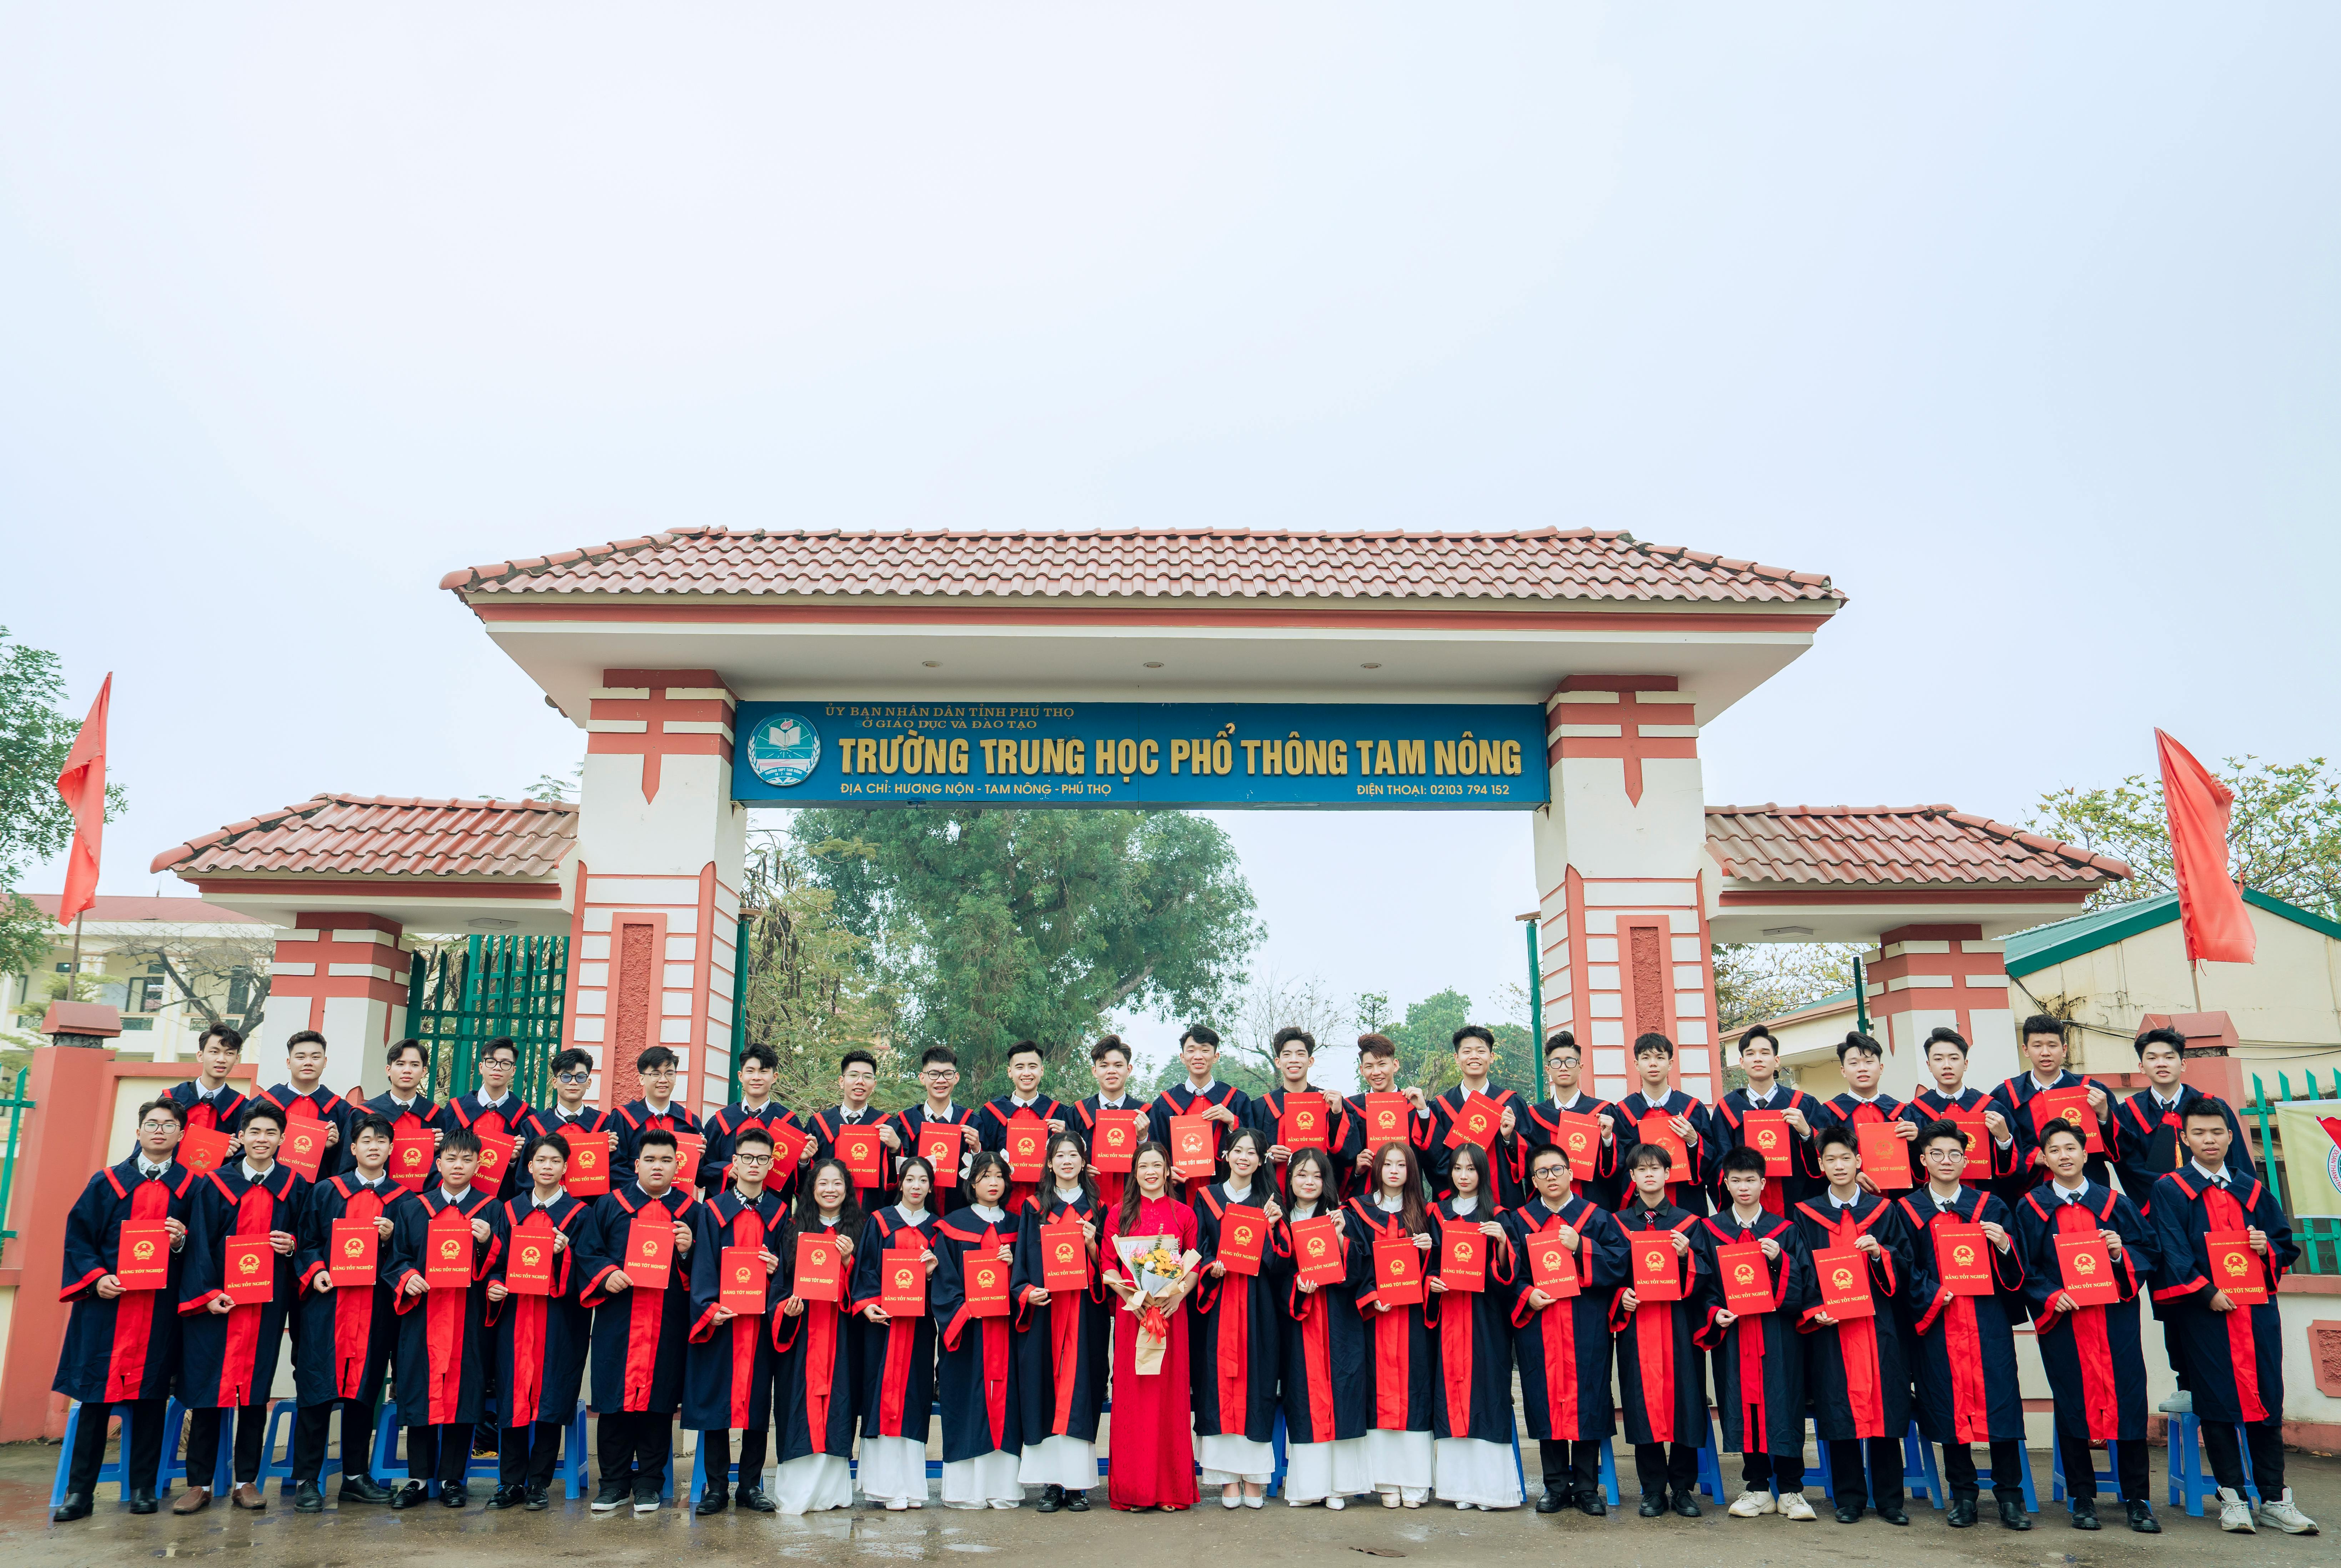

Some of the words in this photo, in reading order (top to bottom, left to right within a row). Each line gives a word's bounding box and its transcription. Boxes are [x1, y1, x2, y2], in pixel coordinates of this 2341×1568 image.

[825, 703, 845, 715] ỦY
[850, 707, 881, 716] BAN
[885, 705, 930, 716] NHÂN
[933, 705, 965, 716] DÂN
[969, 703, 1006, 717] TỈNH
[1009, 705, 1040, 717] PHÚ
[1043, 708, 1074, 719] THỌ
[876, 717, 914, 728] GIÁO
[918, 720, 946, 730] DỤC
[950, 718, 968, 728] VÀ
[971, 718, 1004, 728] ĐÀO
[1007, 720, 1037, 730] TẠO
[838, 729, 969, 775] TRƯỜNG
[980, 738, 1085, 775] TRUNG
[1096, 738, 1159, 783] HỌC
[1171, 723, 1236, 775] PHỔ
[1241, 731, 1348, 775] THÔNG
[1356, 739, 1426, 775] TAM
[1433, 731, 1522, 776] NÔNG
[840, 783, 863, 796] ĐỊA
[866, 780, 891, 793] CHỈ:
[895, 783, 942, 794] HƯƠNG
[945, 782, 974, 796] NỘN
[984, 784, 1010, 794] TAM
[1014, 782, 1052, 794] NÔNG
[1061, 781, 1084, 794] PHÚ
[1086, 784, 1111, 796] THỌ
[1357, 783, 1383, 797] ĐIỆN
[1387, 785, 1427, 797] THOẠI:
[1430, 785, 1463, 795] 02103
[1467, 785, 1488, 795] 794
[1491, 785, 1510, 795] 152
[1452, 1129, 1463, 1137] BẰNG
[772, 1168, 787, 1177] NGHIỆP
[2330, 1165, 2340, 1182] THANH
